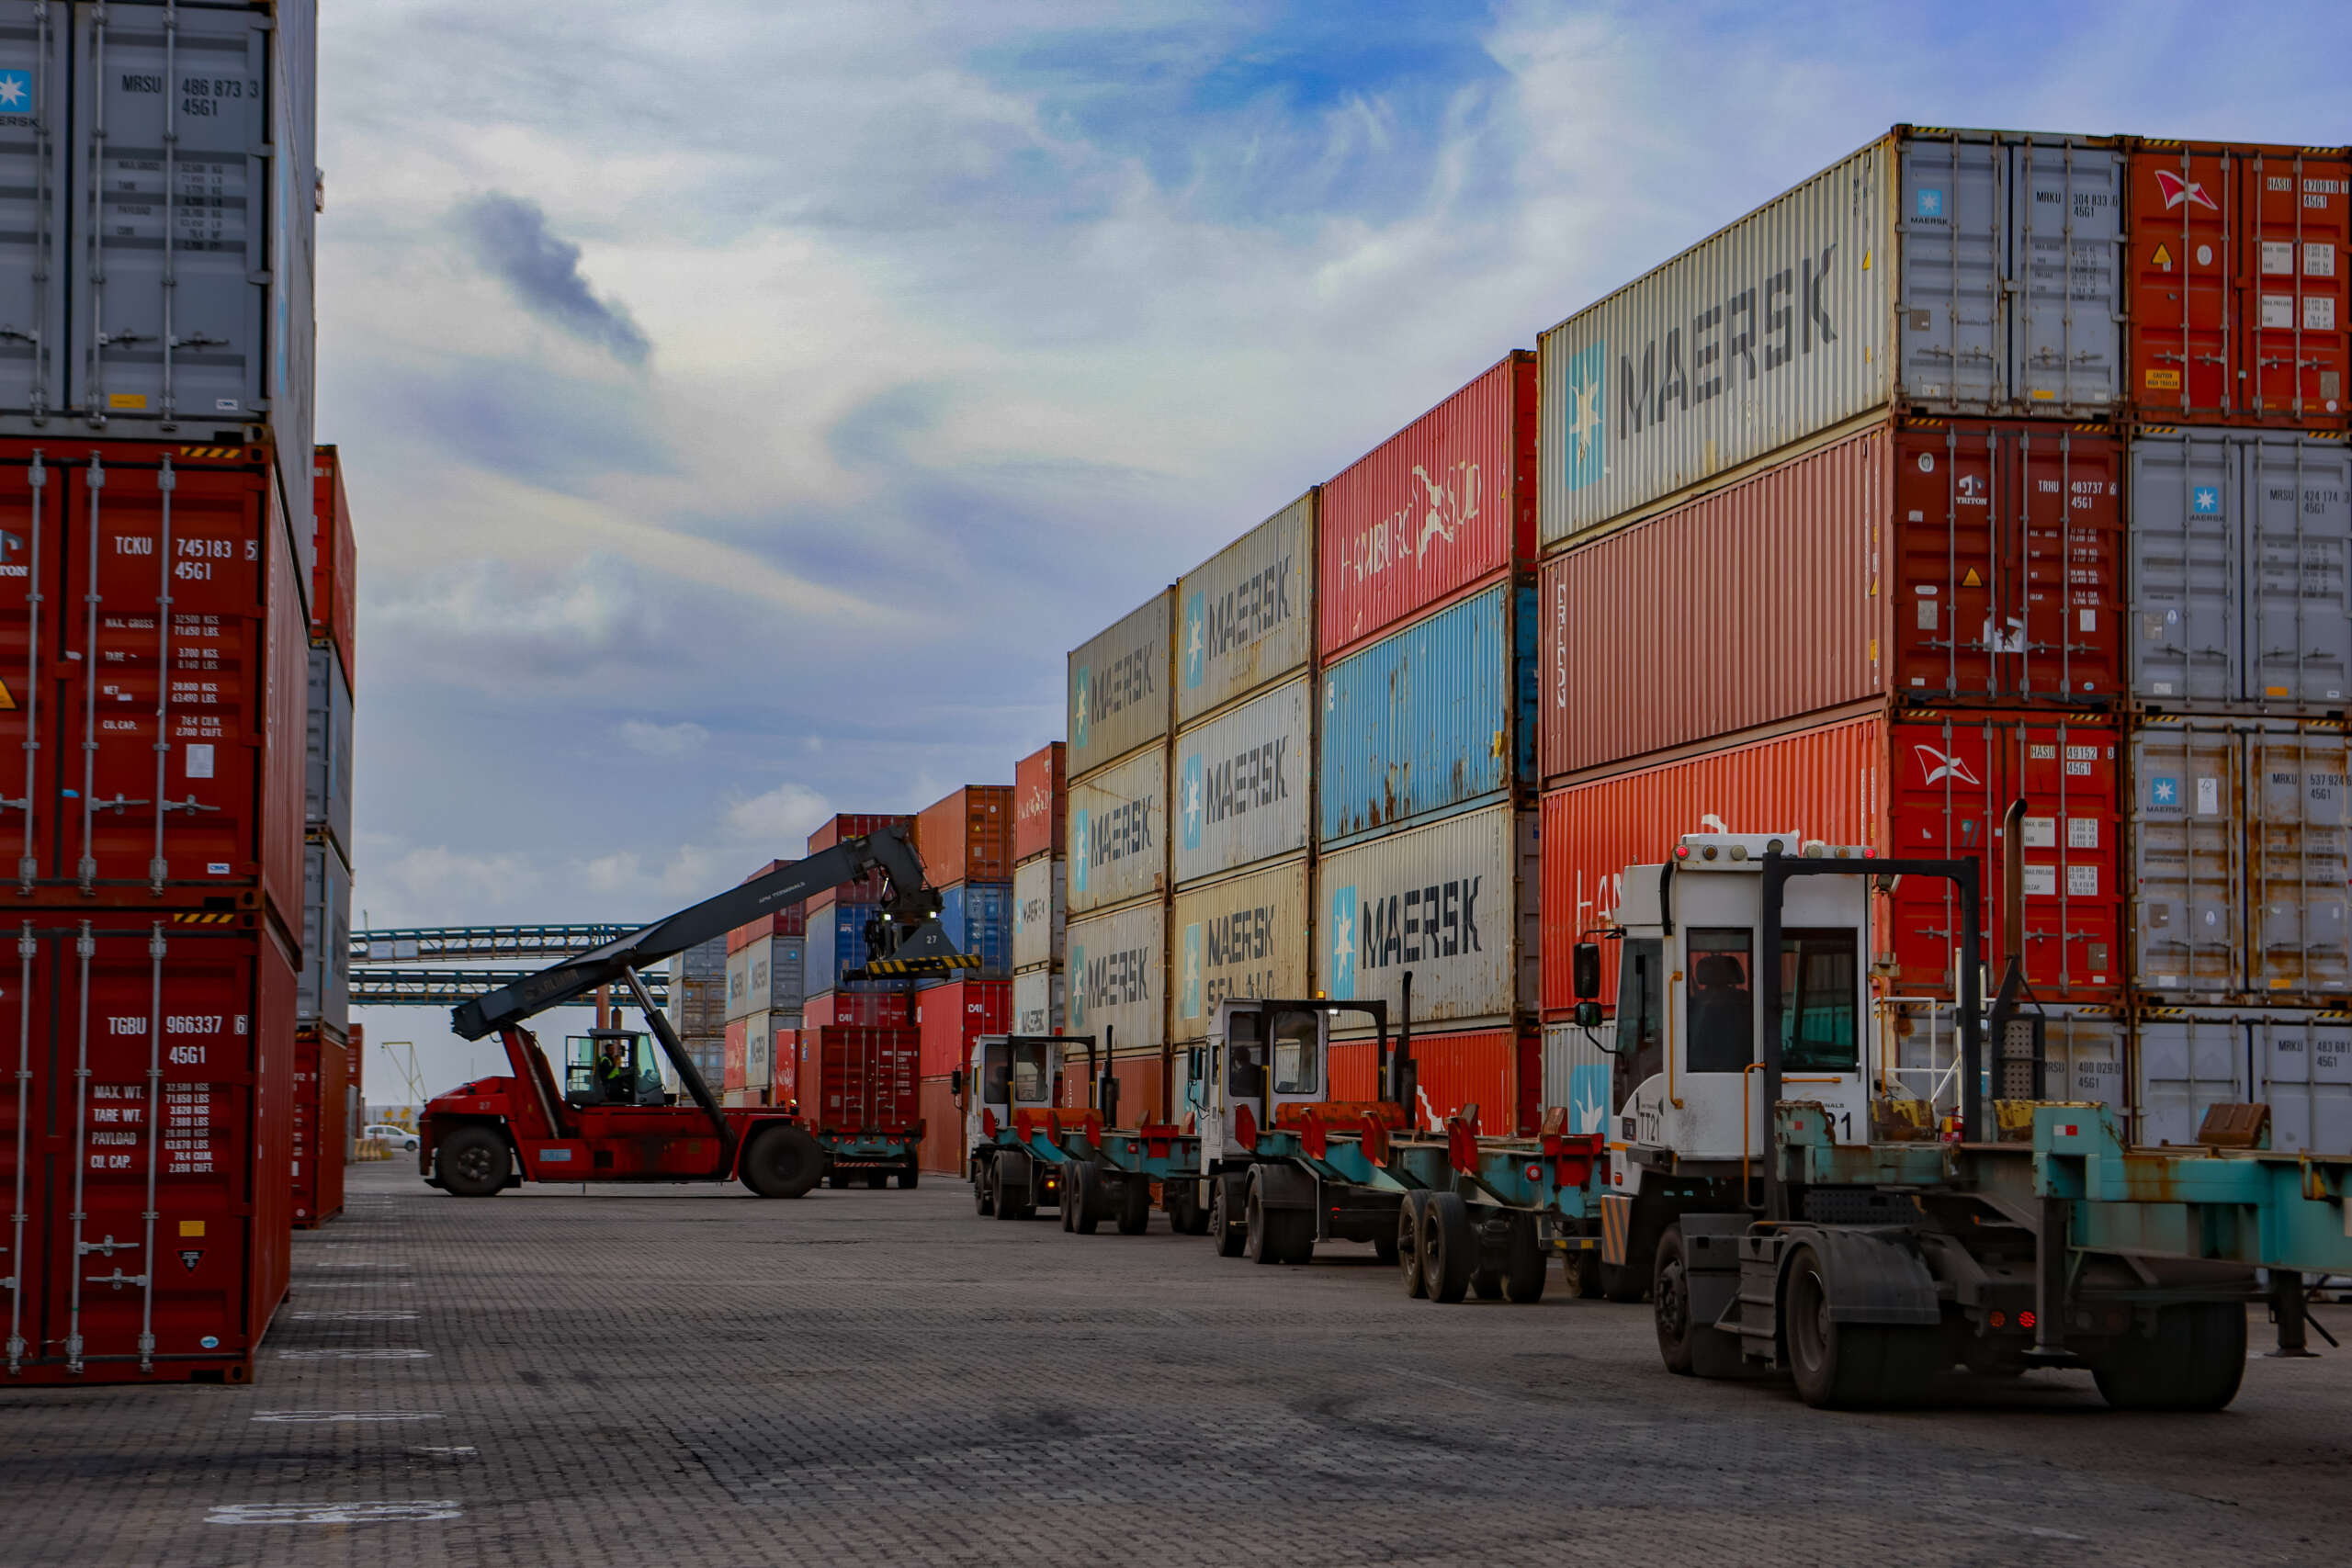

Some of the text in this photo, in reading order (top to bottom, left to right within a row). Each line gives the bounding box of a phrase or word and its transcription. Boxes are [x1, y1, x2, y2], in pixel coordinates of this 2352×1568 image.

[121, 74, 259, 98] MRSU 486 873 3
[182, 98, 219, 117] 45G1
[2267, 176, 2291, 191] HASU
[2036, 191, 2061, 204] MRKU
[2304, 195, 2326, 209] 45G1
[2074, 206, 2094, 218] 45G1
[1910, 216, 1948, 227] MAERSK
[1619, 242, 1838, 441] MAERSK
[2039, 480, 2117, 495] TRHU 483737 6
[1956, 496, 1987, 506] TRITON
[2072, 497, 2092, 509] 45G1
[2269, 490, 2294, 501] MRSU
[2304, 490, 2320, 502] 424
[2324, 491, 2338, 502] 174
[2304, 502, 2324, 514] 45G1
[114, 536, 258, 560] TCKU 745183 5
[175, 561, 212, 581] 45G1
[1209, 553, 1292, 661] MAERSK
[1091, 640, 1155, 726] MAERSK
[2030, 745, 2055, 759] HASU
[2067, 747, 2097, 760] 49152
[2067, 762, 2090, 774] 45G1
[1206, 735, 1289, 827] MAERSK
[2273, 773, 2298, 785] MRKU
[2310, 773, 2326, 785] 537
[2329, 774, 2344, 786] 924
[2311, 788, 2331, 800] 45G1
[1091, 795, 1153, 868] MAERSK
[1363, 874, 1483, 969] MAERSK
[925, 935, 938, 944] 27
[1207, 904, 1275, 968] MAERSK
[1088, 946, 1149, 1010] MAERSK
[107, 1015, 248, 1035] TGBU 966337 6
[2278, 1040, 2303, 1052] MRKU
[2317, 1041, 2332, 1053] 483
[169, 1045, 206, 1065] 45G1
[2317, 1055, 2337, 1067] 45G1
[2097, 1062, 2113, 1074] 029
[2078, 1077, 2099, 1089] 45G1
[94, 1109, 119, 1122] TARE
[92, 1132, 137, 1145] PAYLOAD
